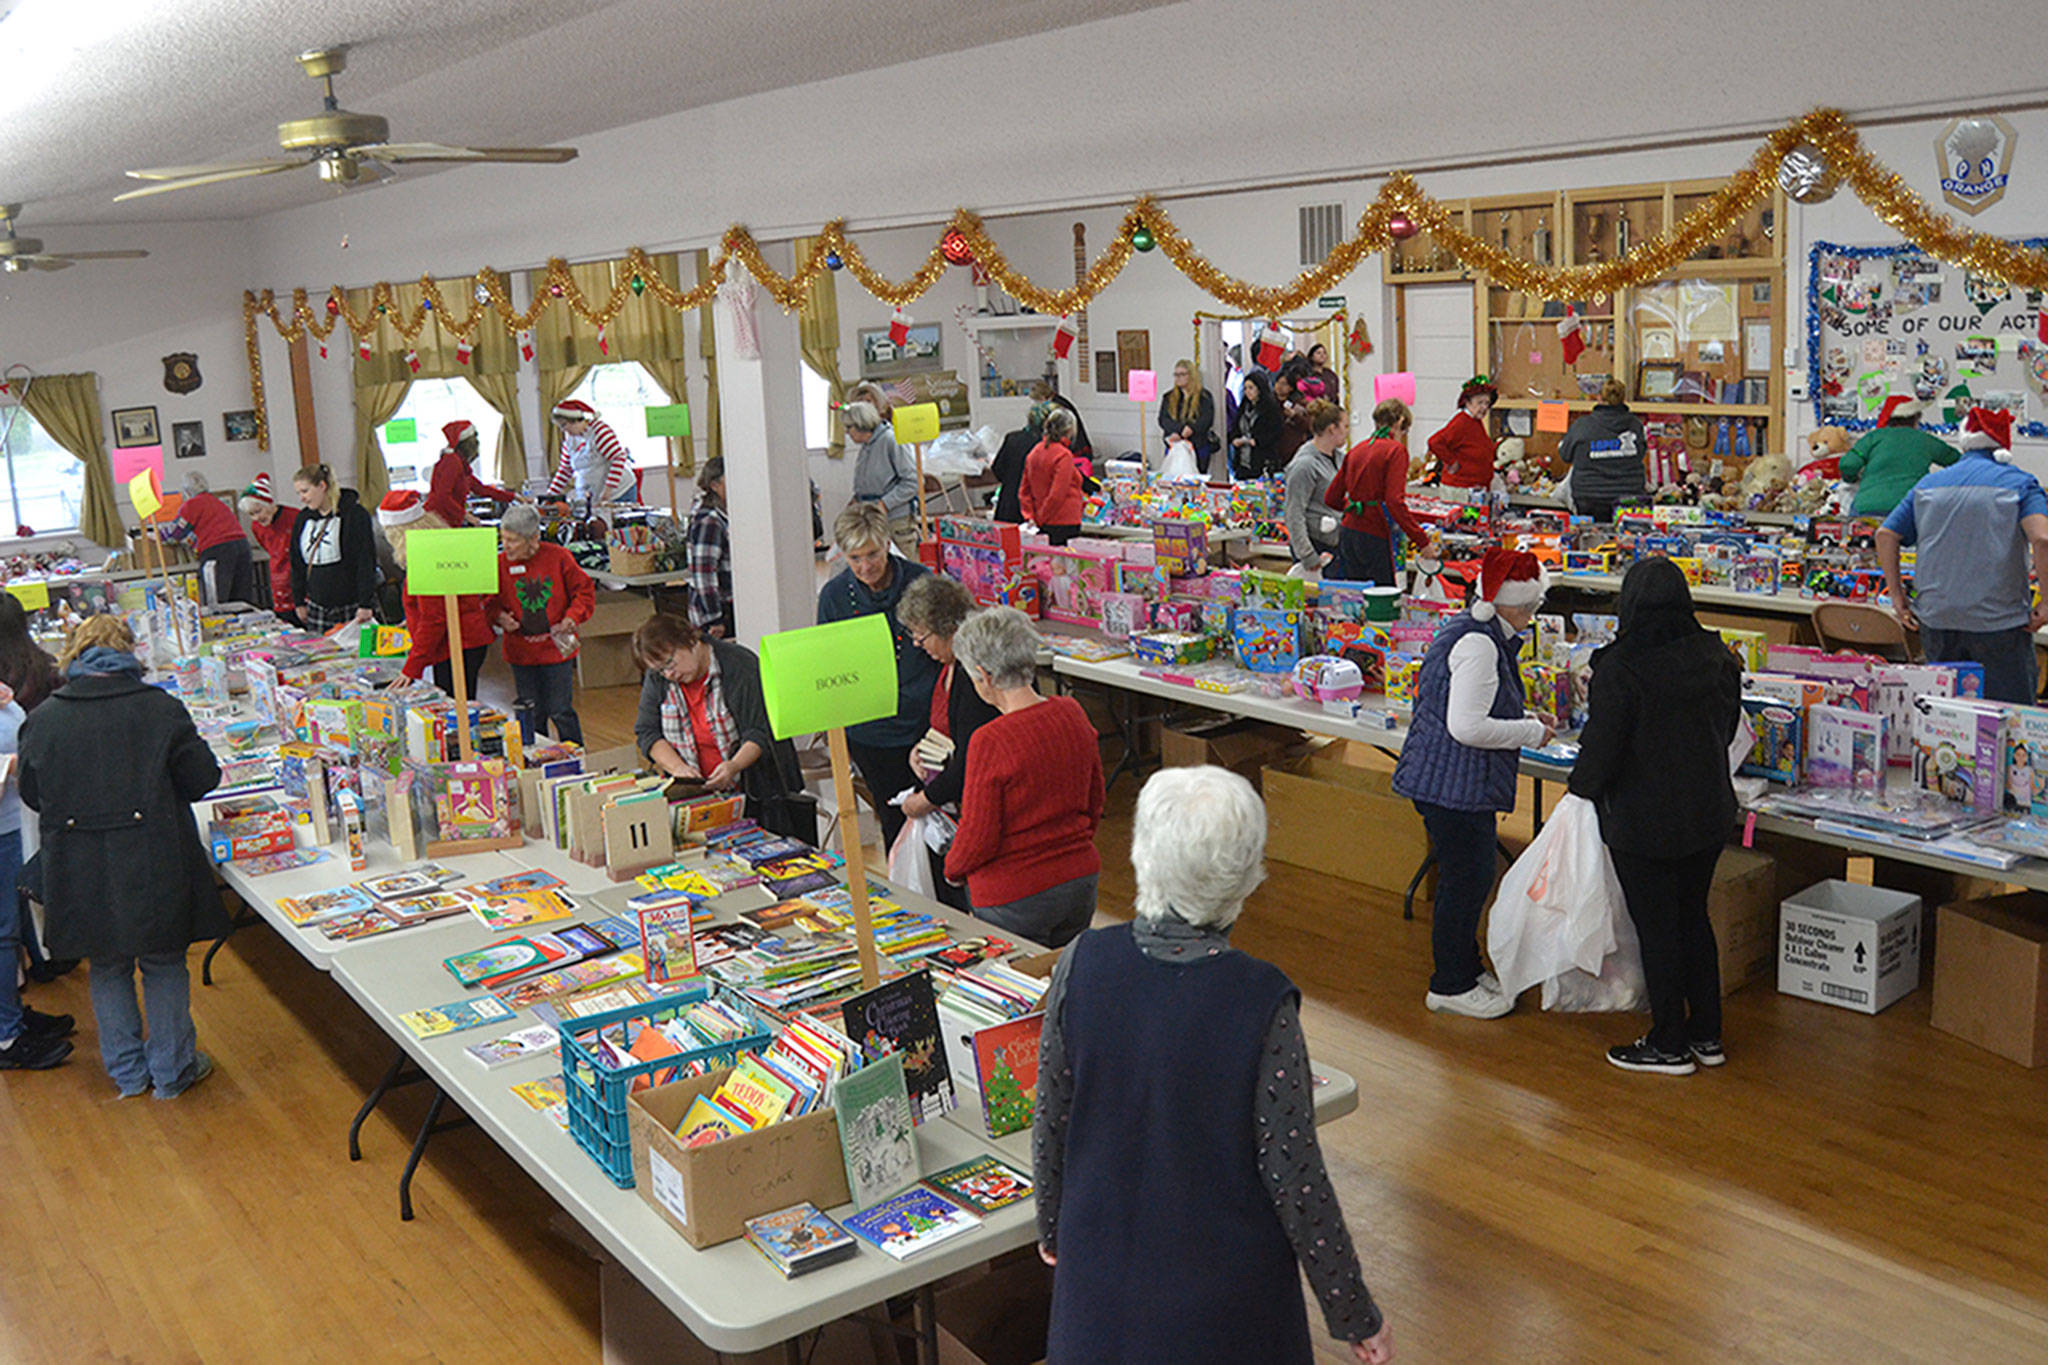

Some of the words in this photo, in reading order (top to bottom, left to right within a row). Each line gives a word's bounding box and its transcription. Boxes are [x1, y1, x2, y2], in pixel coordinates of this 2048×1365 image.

[1943, 174, 2008, 195] ORANGE
[1843, 319, 1889, 337] SOME
[1902, 318, 1928, 333] OF
[1938, 315, 1983, 331] OUR
[436, 560, 469, 570] BOOKS
[815, 672, 861, 691] BOOKS
[630, 821, 649, 849] 11
[1797, 923, 1837, 941] SECONDS
[1784, 932, 1815, 948] Outdoor
[1816, 939, 1846, 954] Cleaner
[1784, 953, 1830, 972] Concentrate
[1804, 946, 1828, 960] Gallon
